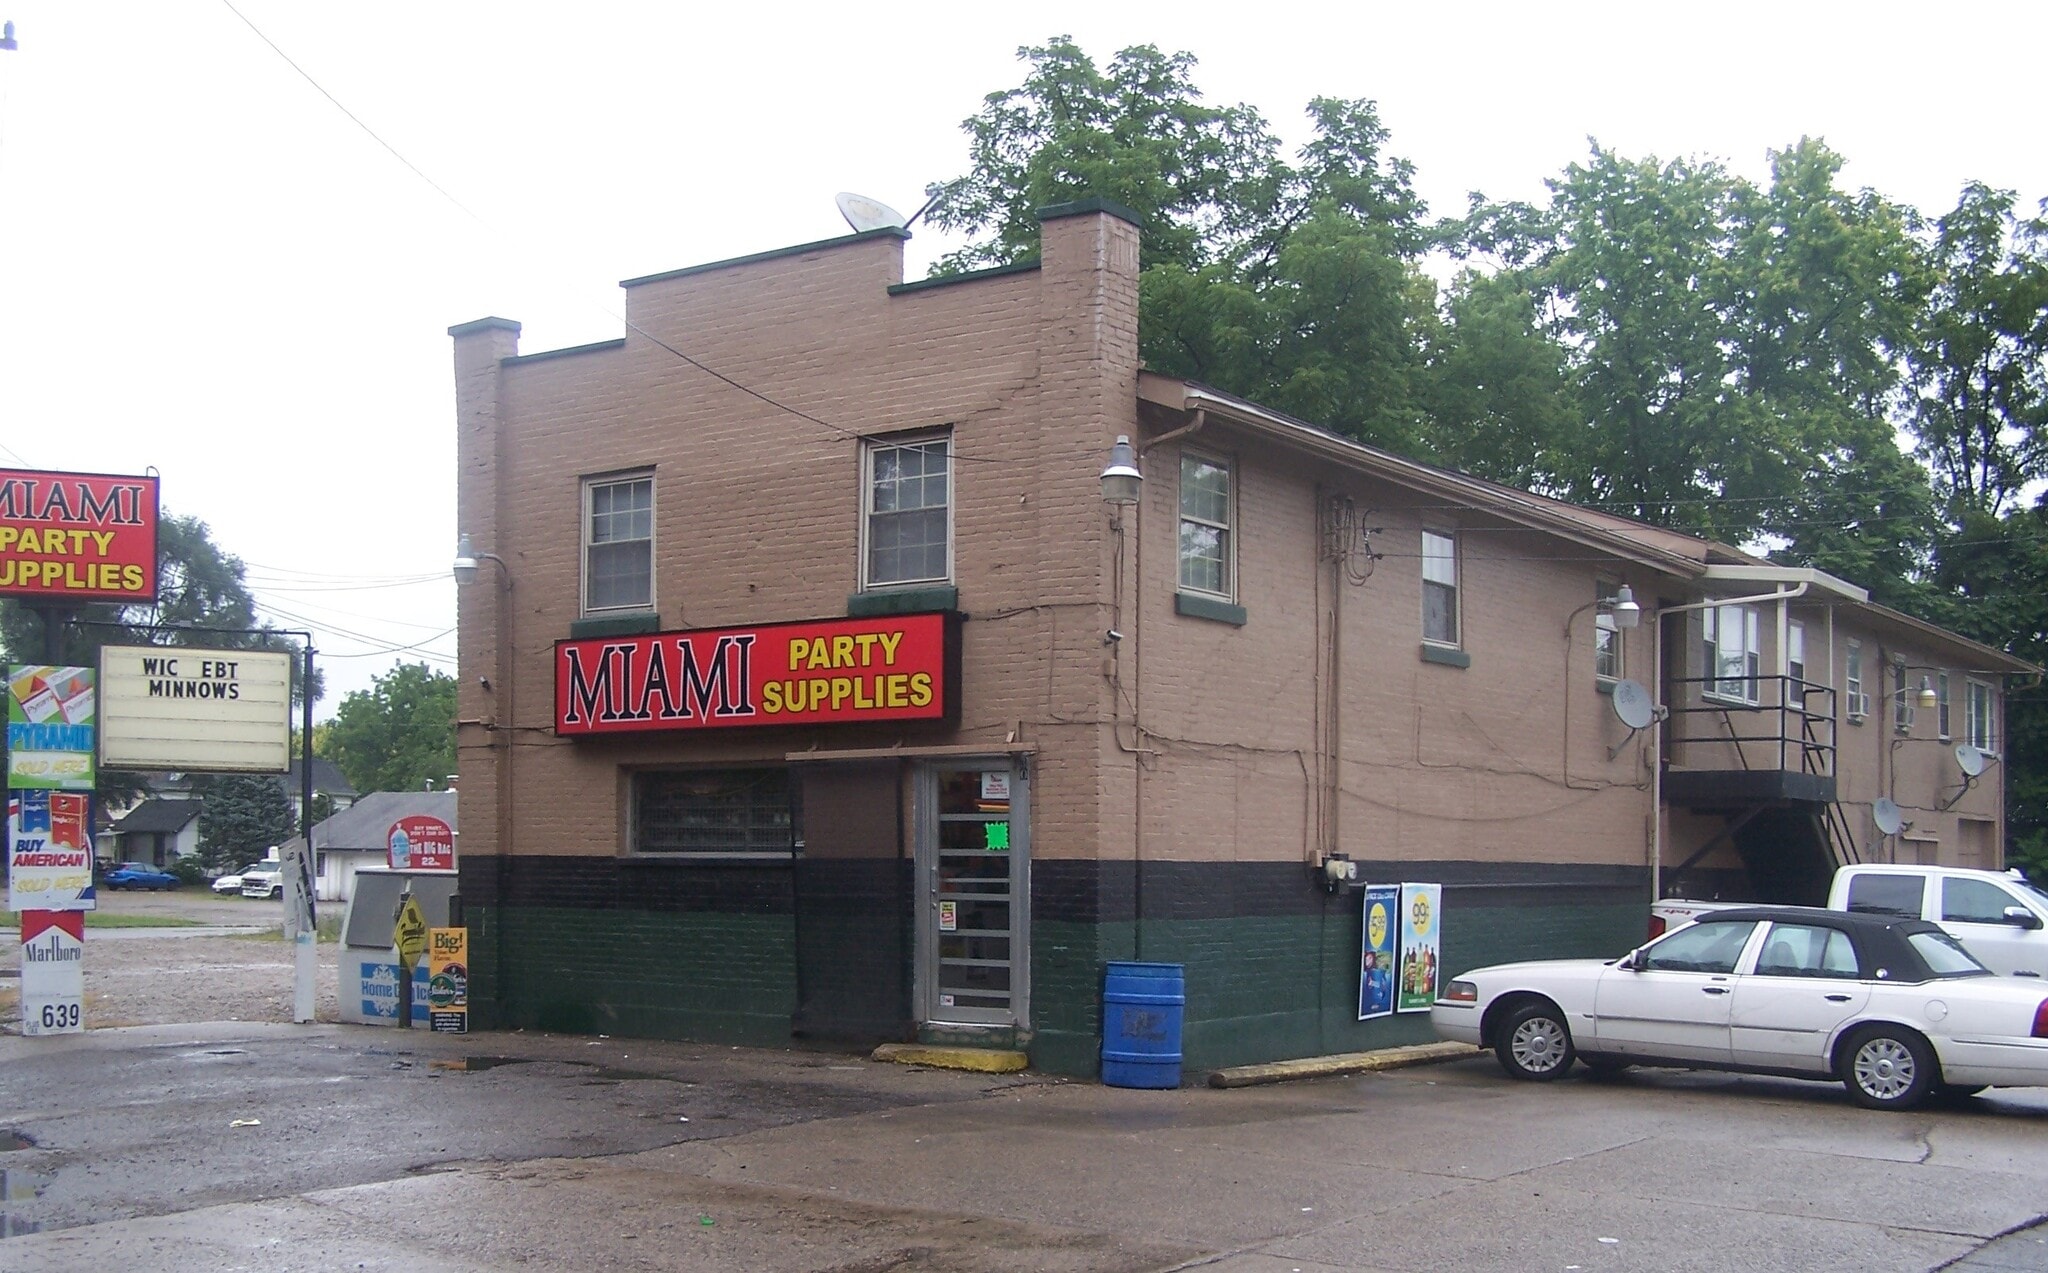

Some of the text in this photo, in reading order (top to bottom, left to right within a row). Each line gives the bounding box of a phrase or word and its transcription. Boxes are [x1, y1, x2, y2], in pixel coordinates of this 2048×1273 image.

[0, 526, 116, 556] PARTY
[788, 631, 904, 671] PARTY
[143, 658, 239, 679] WIC EBT
[149, 679, 239, 699] MINNOWS
[565, 634, 756, 729] MIAMI
[762, 673, 932, 715] SUPPLIES
[8, 722, 95, 752] PYRAMID
[16, 839, 46, 853] BUY
[13, 854, 85, 867] AMERICAN
[26, 935, 81, 962] Marlboro
[434, 932, 463, 953] Big!
[361, 980, 392, 998] Home
[42, 1003, 80, 1028] 639
